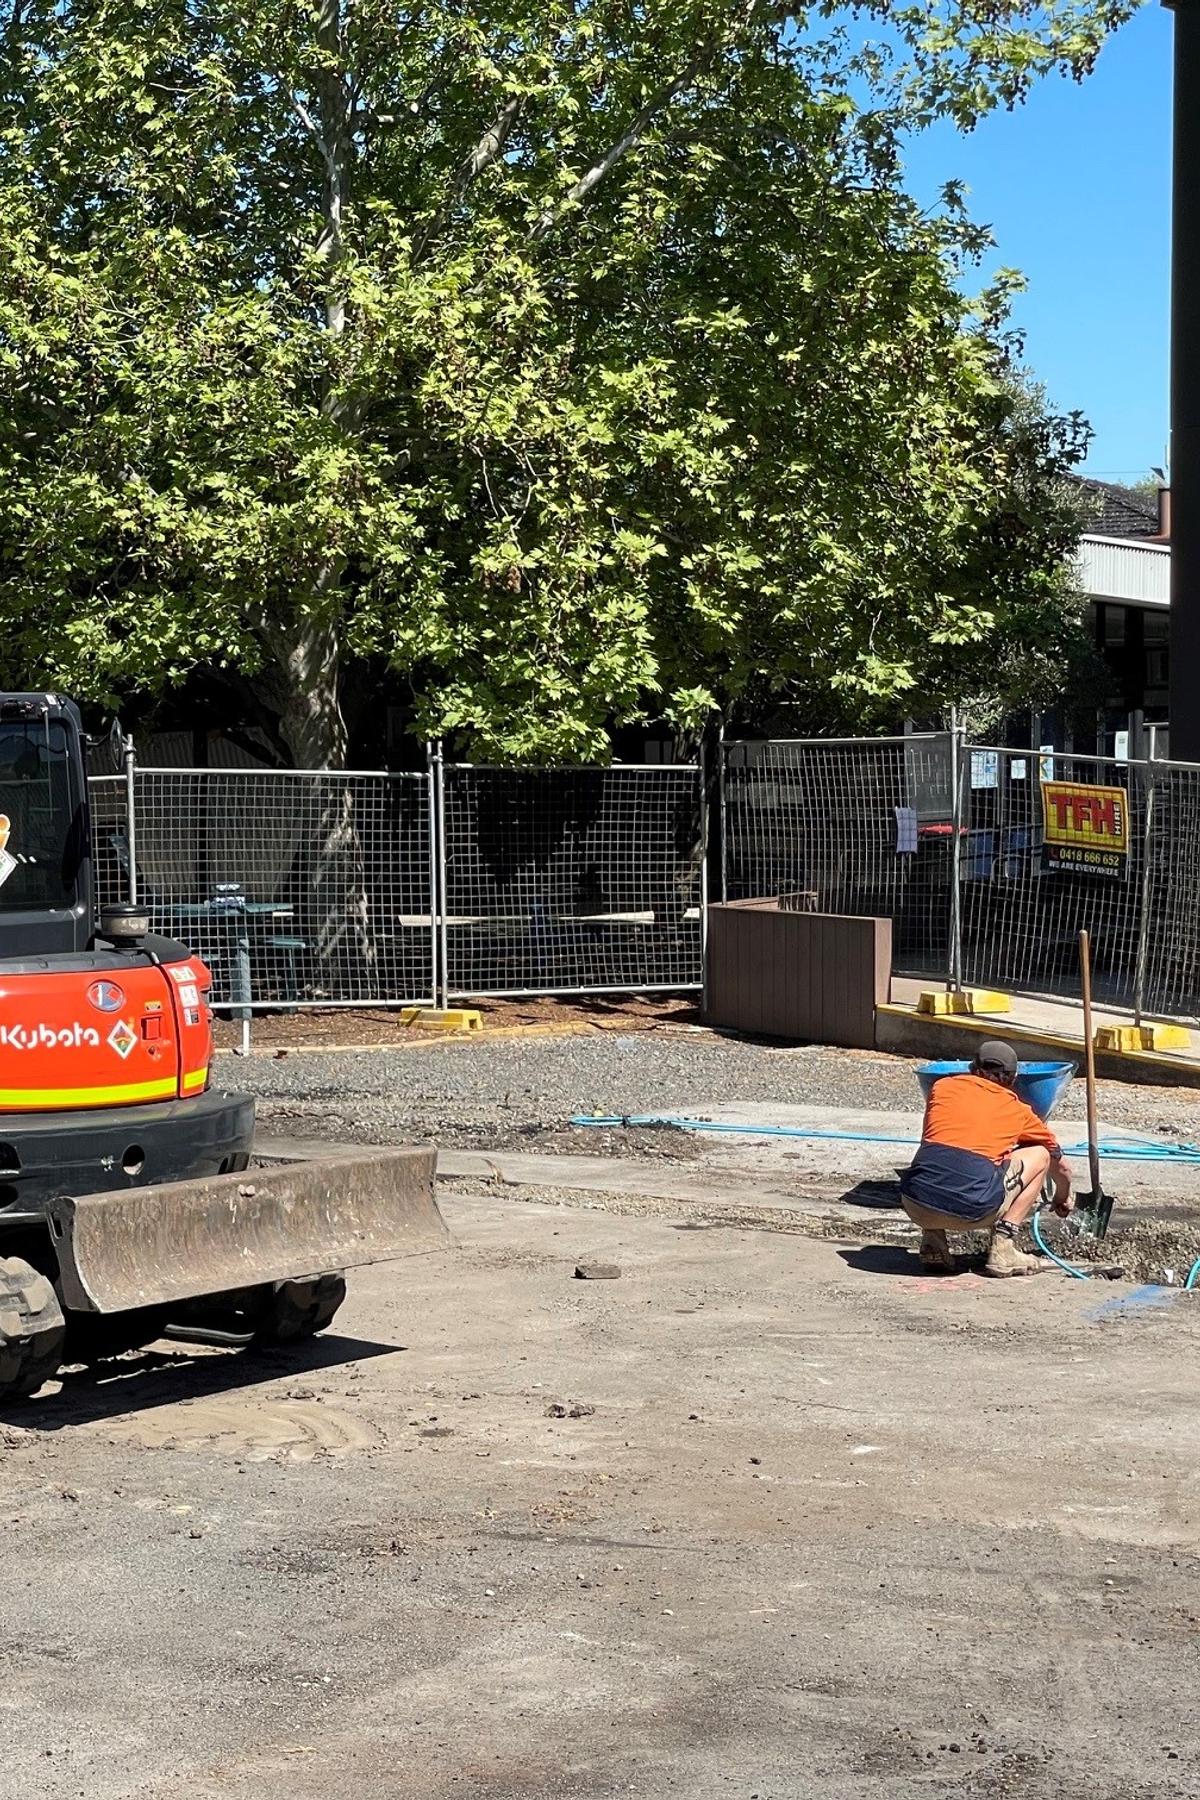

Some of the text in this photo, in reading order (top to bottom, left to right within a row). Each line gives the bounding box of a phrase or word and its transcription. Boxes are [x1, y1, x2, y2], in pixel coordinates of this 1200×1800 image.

[1049, 794, 1114, 834] TFH
[1113, 803, 1121, 834] HIRE
[1059, 848, 1120, 867] 0418 666 652
[1060, 861, 1074, 871] ARE
[0, 1021, 100, 1050] Kubota
